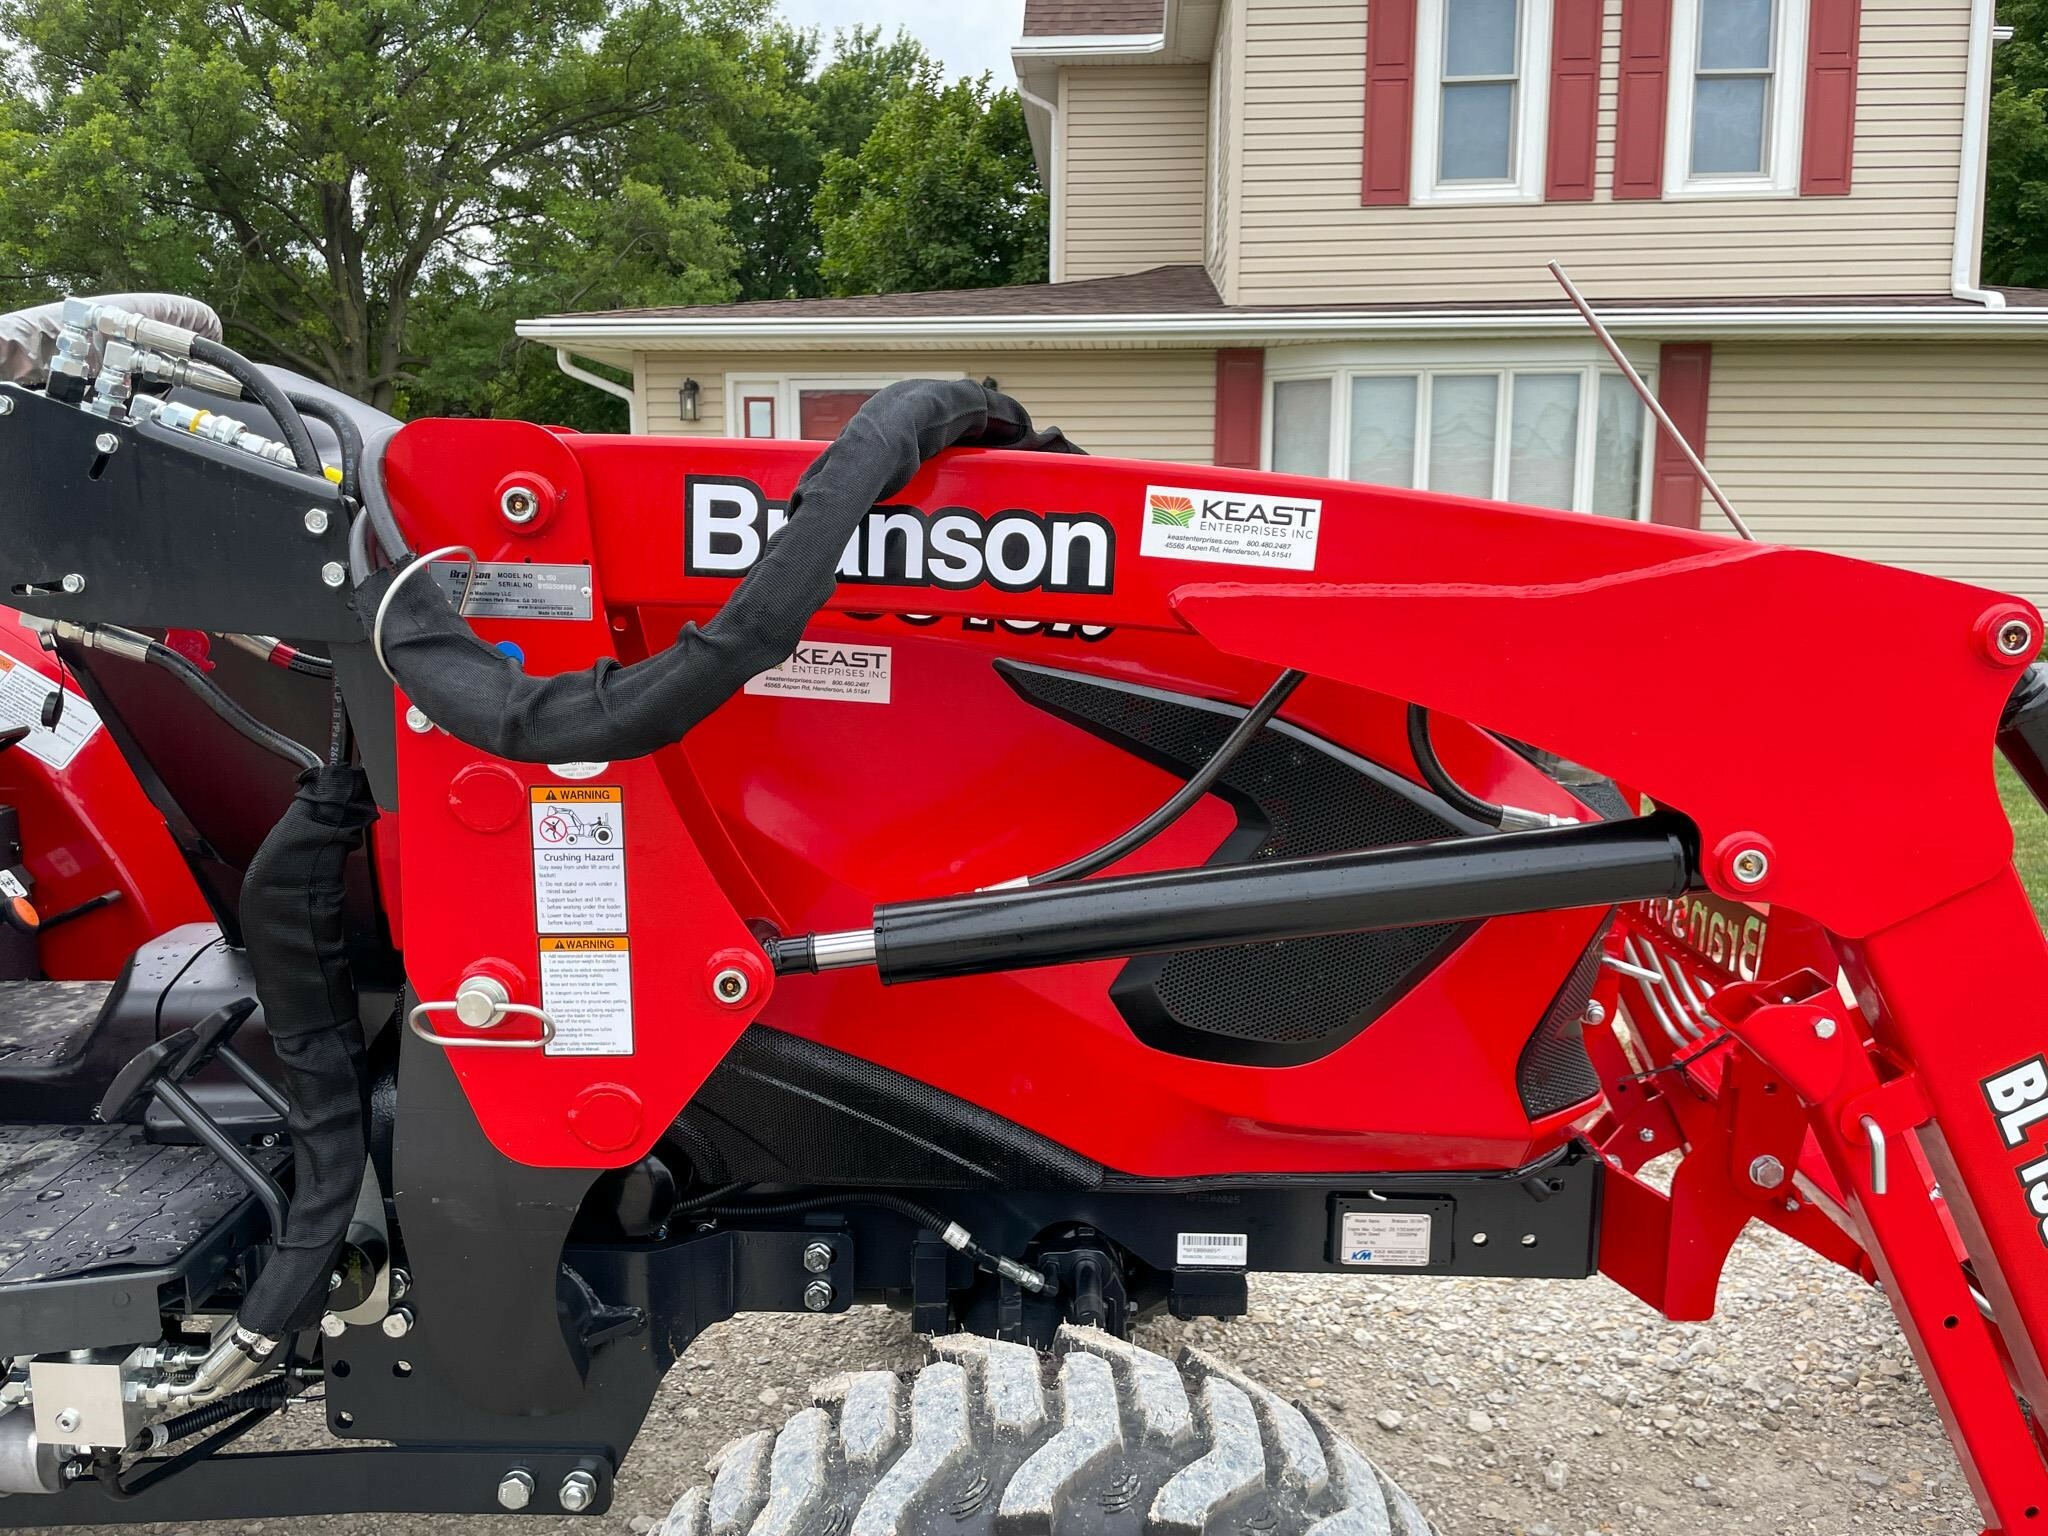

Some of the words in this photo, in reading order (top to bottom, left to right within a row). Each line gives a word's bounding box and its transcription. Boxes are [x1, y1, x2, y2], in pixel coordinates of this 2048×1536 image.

[1202, 500, 1316, 527] KEAST
[1200, 521, 1286, 538] ENTERPRISES
[1292, 529, 1313, 540] INC
[1167, 533, 1239, 546] keastenterprises.com
[1246, 540, 1291, 549] 800.480.2487
[1186, 544, 1208, 552] Aspen
[1222, 548, 1261, 557] Henderson,
[792, 648, 887, 668] KEAST
[792, 665, 865, 677] ENTERPRISES
[869, 670, 887, 679] INC
[765, 676, 826, 685] keastenterprises.com
[560, 790, 610, 800] WARNING
[544, 853, 582, 863] Crushing
[584, 853, 614, 862] Hazard
[566, 940, 615, 949] WARNING
